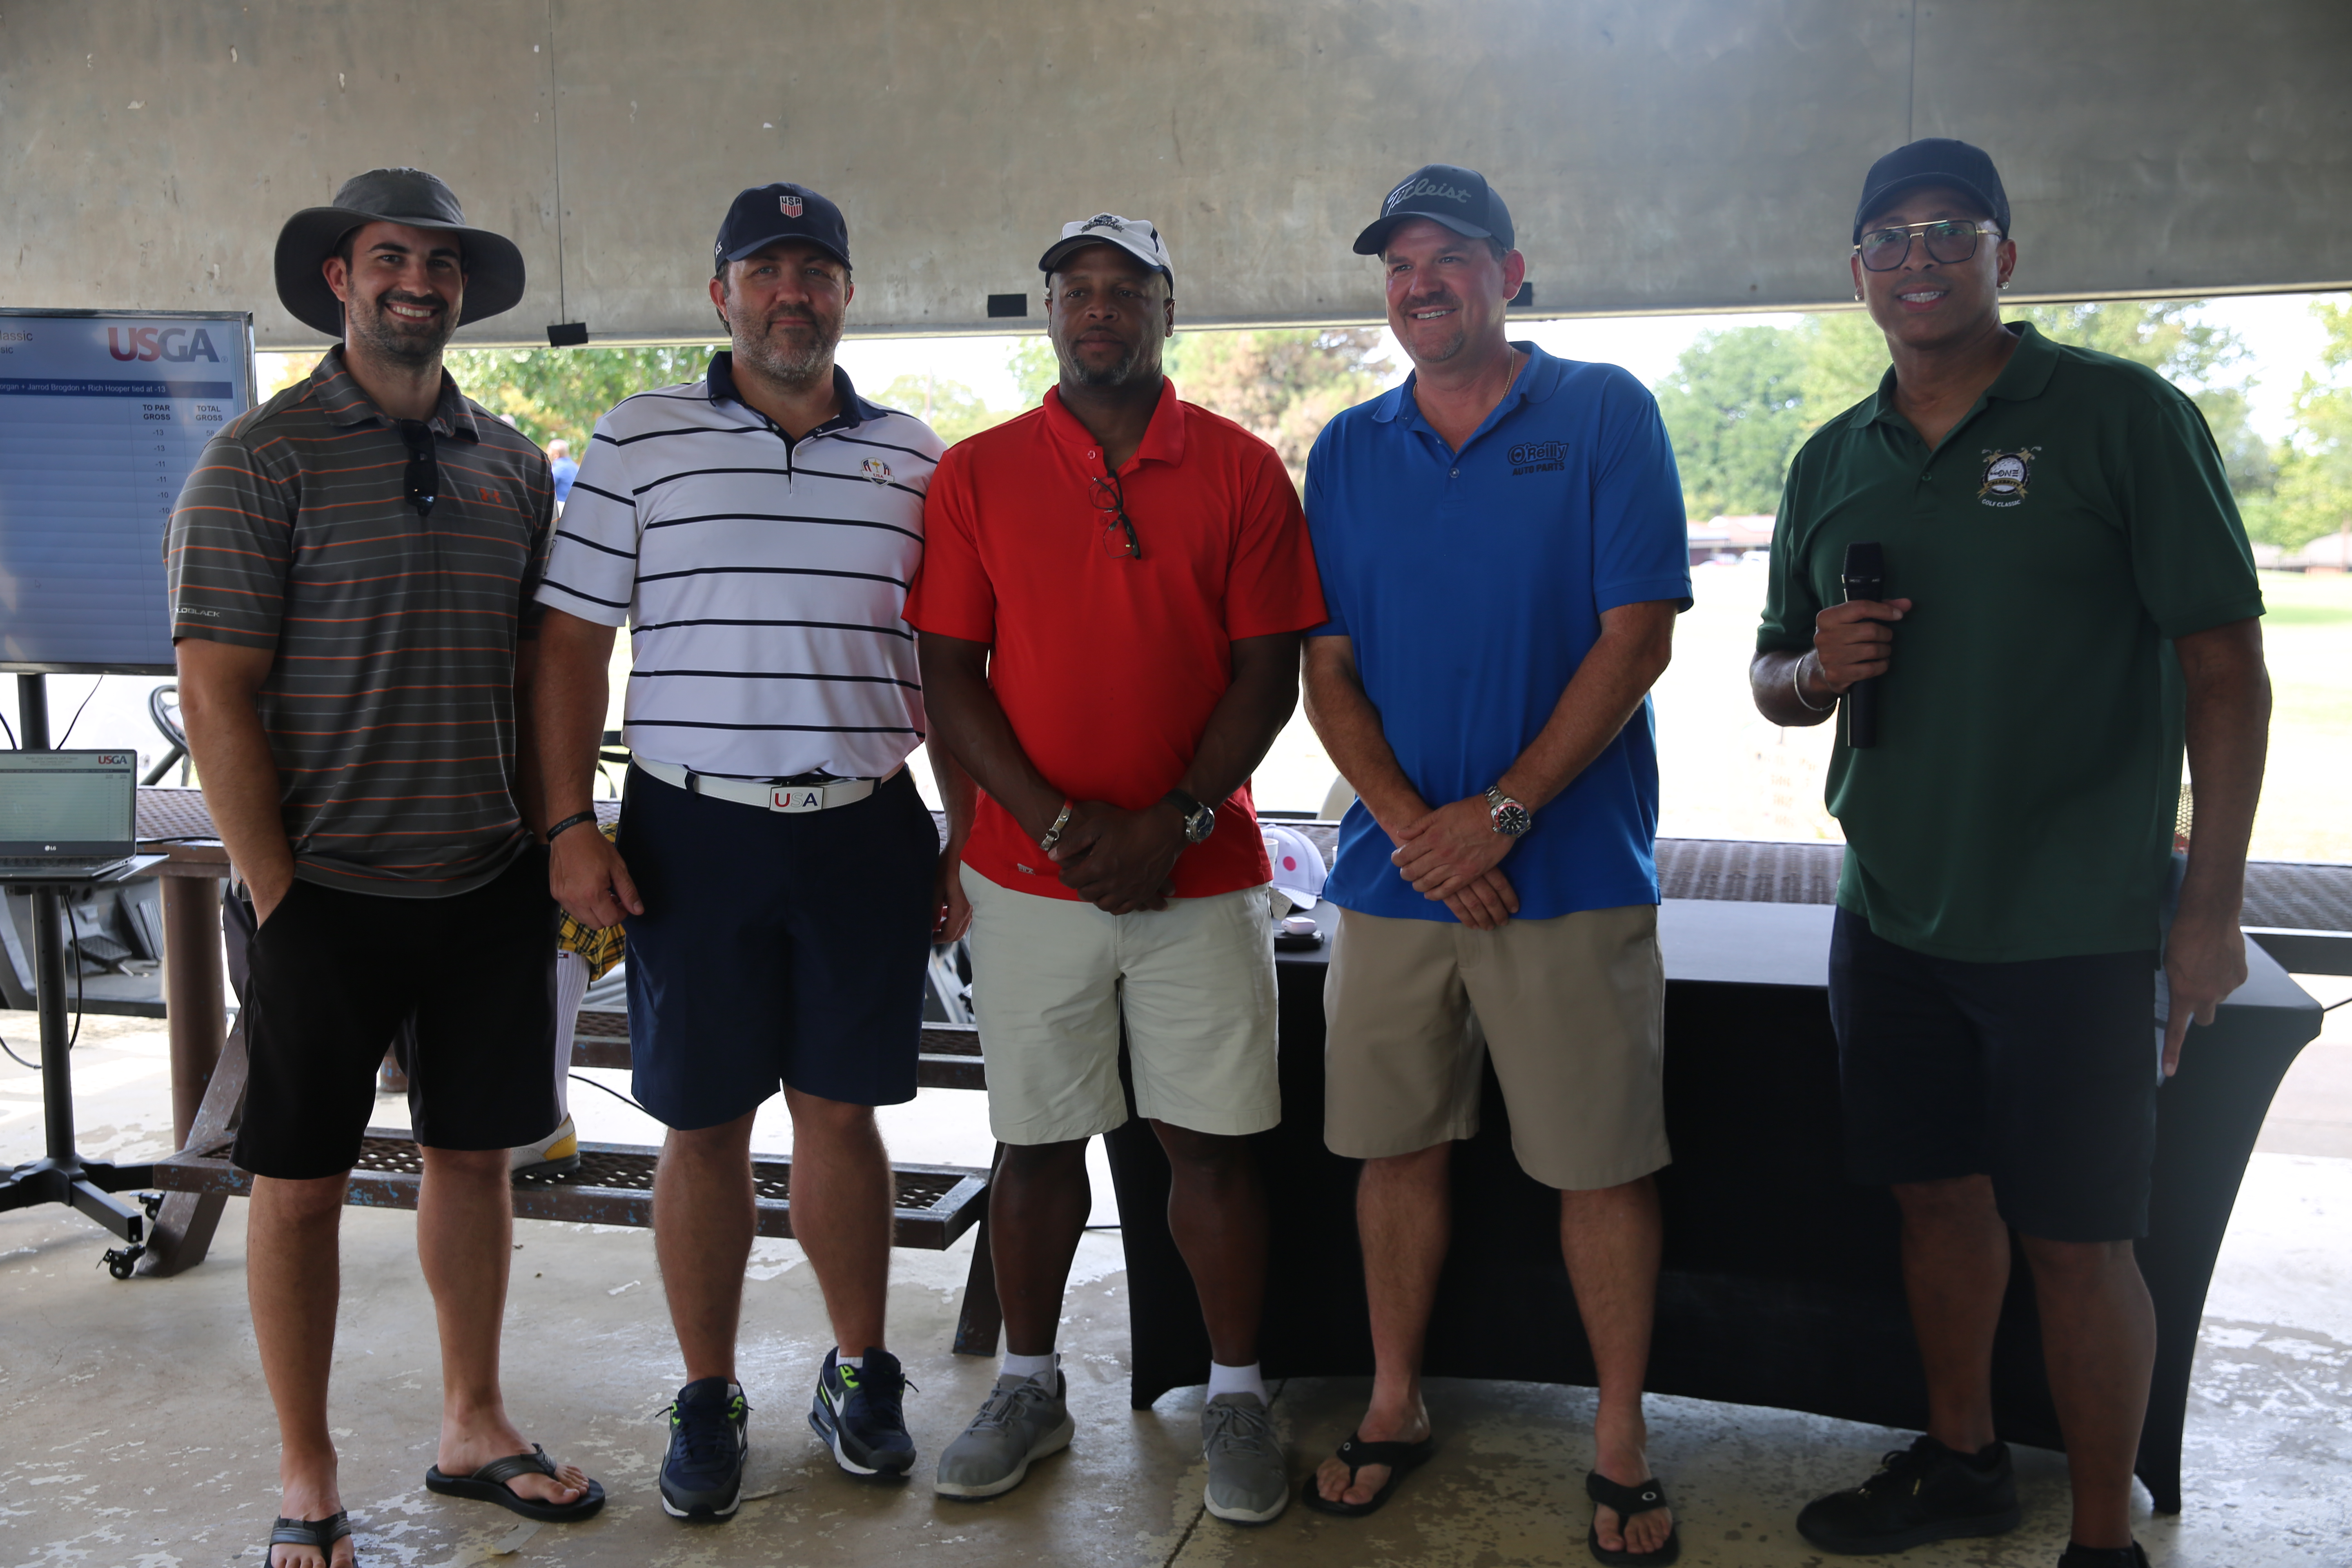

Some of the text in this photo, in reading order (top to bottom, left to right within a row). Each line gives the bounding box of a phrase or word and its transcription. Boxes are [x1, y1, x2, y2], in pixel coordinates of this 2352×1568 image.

[781, 196, 801, 206] USA
[1385, 177, 1471, 217] Titleist
[108, 327, 220, 363] USGA
[105, 385, 129, 393] Hooper
[1508, 442, 1569, 465] O'Reilly
[1512, 462, 1565, 476] AUTO PARTS
[98, 755, 127, 764] USGA
[775, 792, 818, 808] USA
